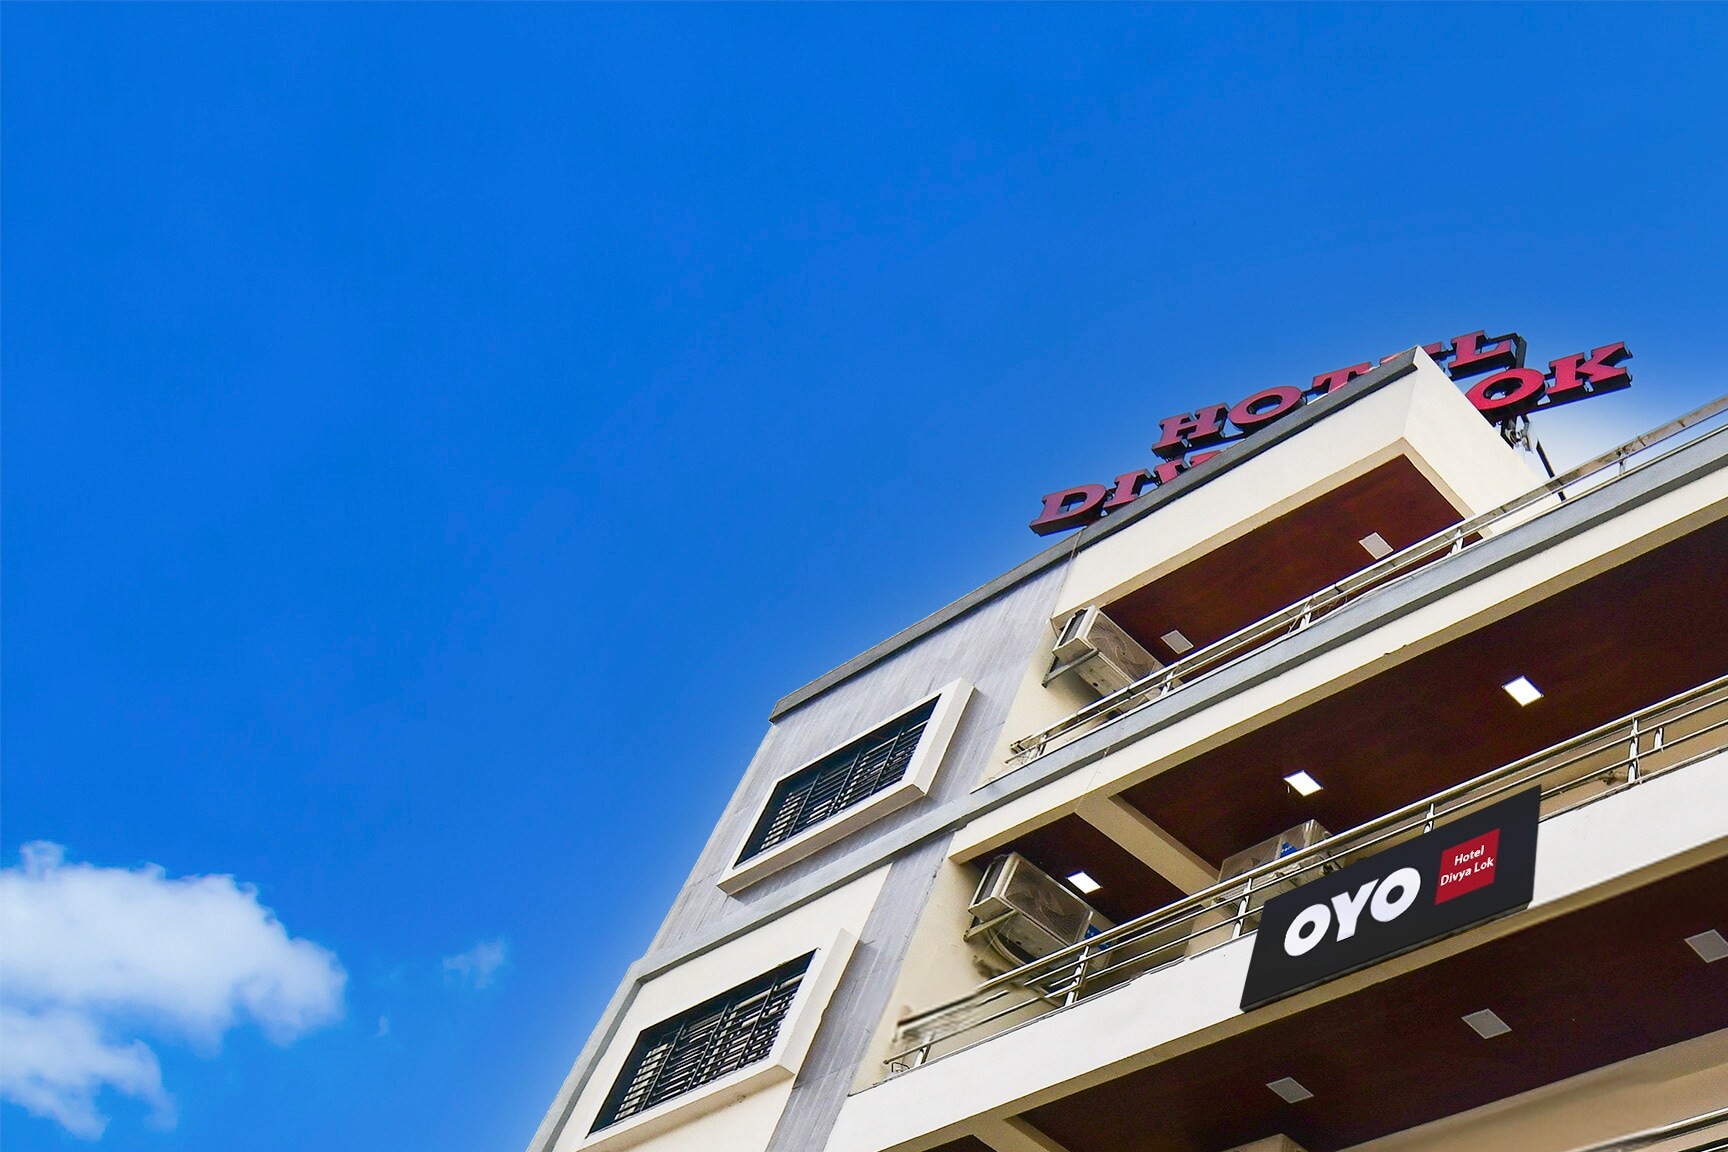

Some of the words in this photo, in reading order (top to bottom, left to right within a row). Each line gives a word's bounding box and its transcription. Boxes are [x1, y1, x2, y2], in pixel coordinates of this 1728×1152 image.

[1151, 329, 1524, 455] HOTL
[1464, 341, 1632, 414] OK
[1440, 867, 1472, 887] Divya
[1474, 856, 1495, 873] Lok
[1454, 844, 1485, 866] Hotel
[1284, 867, 1421, 957] OYO
